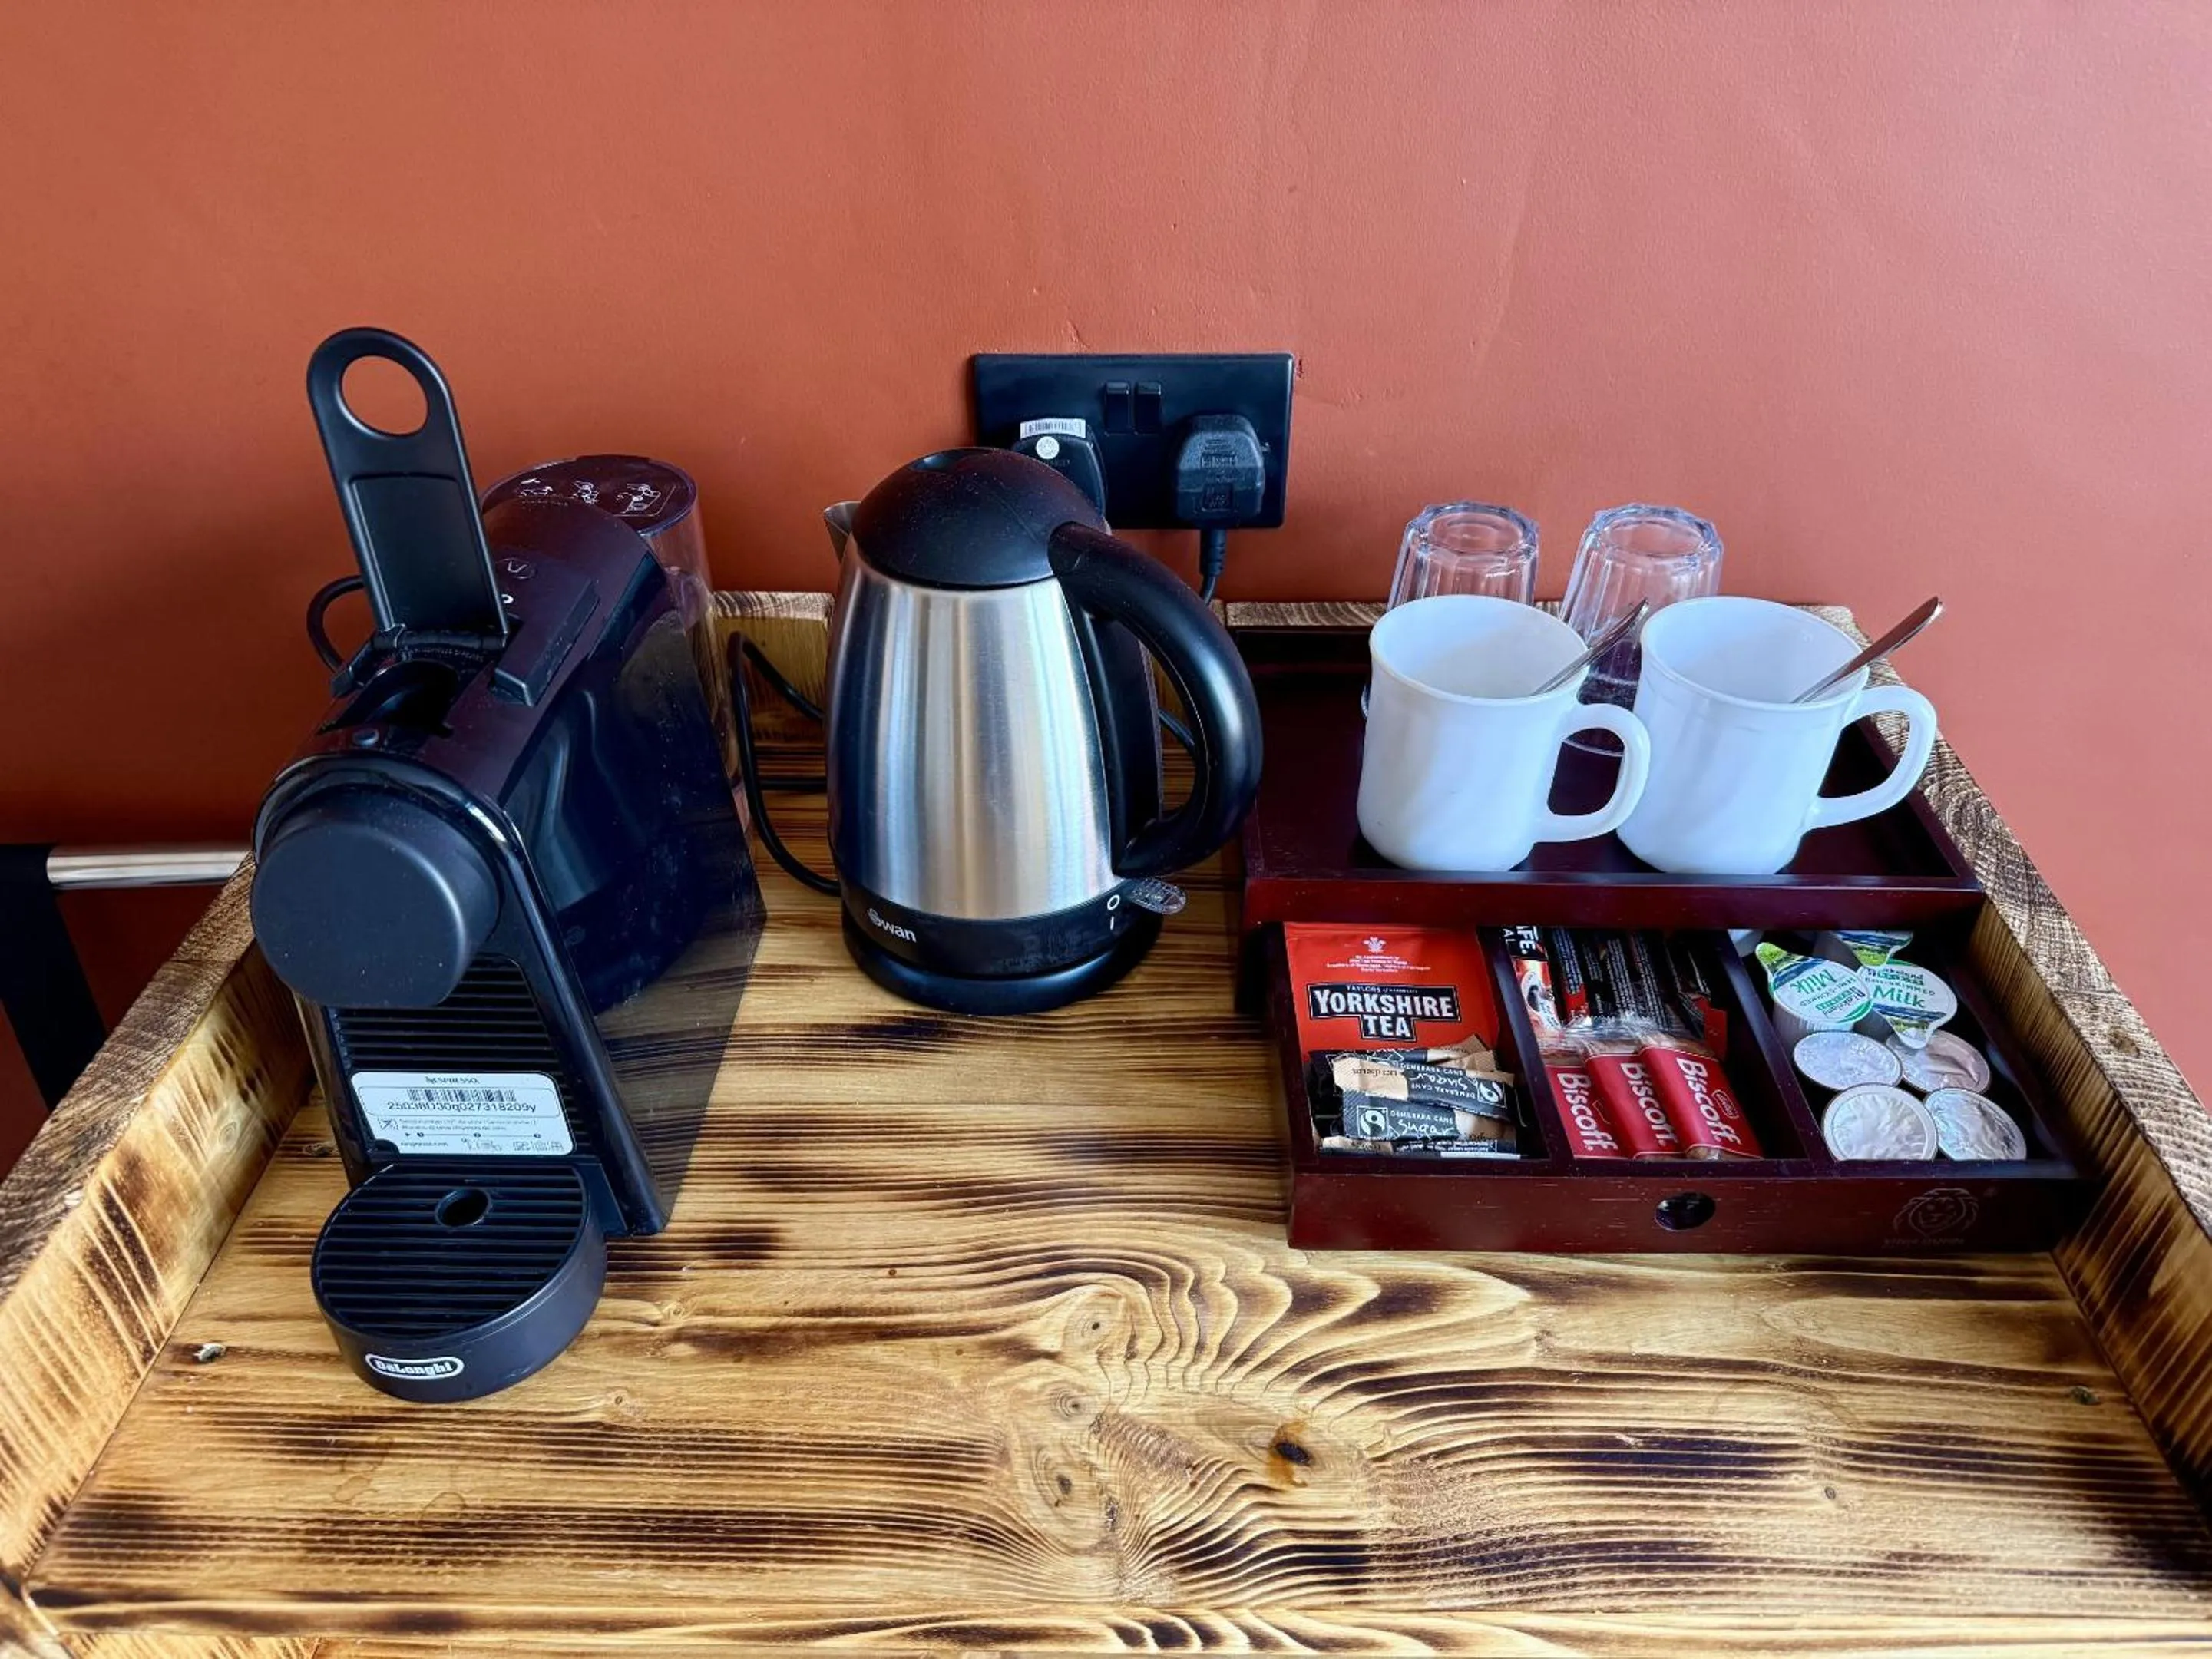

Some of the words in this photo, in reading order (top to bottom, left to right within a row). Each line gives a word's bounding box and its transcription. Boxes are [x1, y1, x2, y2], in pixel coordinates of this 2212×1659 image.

[867, 907, 917, 943] Swan
[1789, 968, 1837, 995] Milk
[1314, 988, 1454, 1017] YORKSHIRE
[1873, 984, 1926, 1008] Milk
[1363, 1014, 1411, 1037] TEA
[1556, 1072, 1619, 1151] Biscoff
[1676, 1056, 1743, 1145] Biscoff
[1397, 1119, 1455, 1139] Sugar
